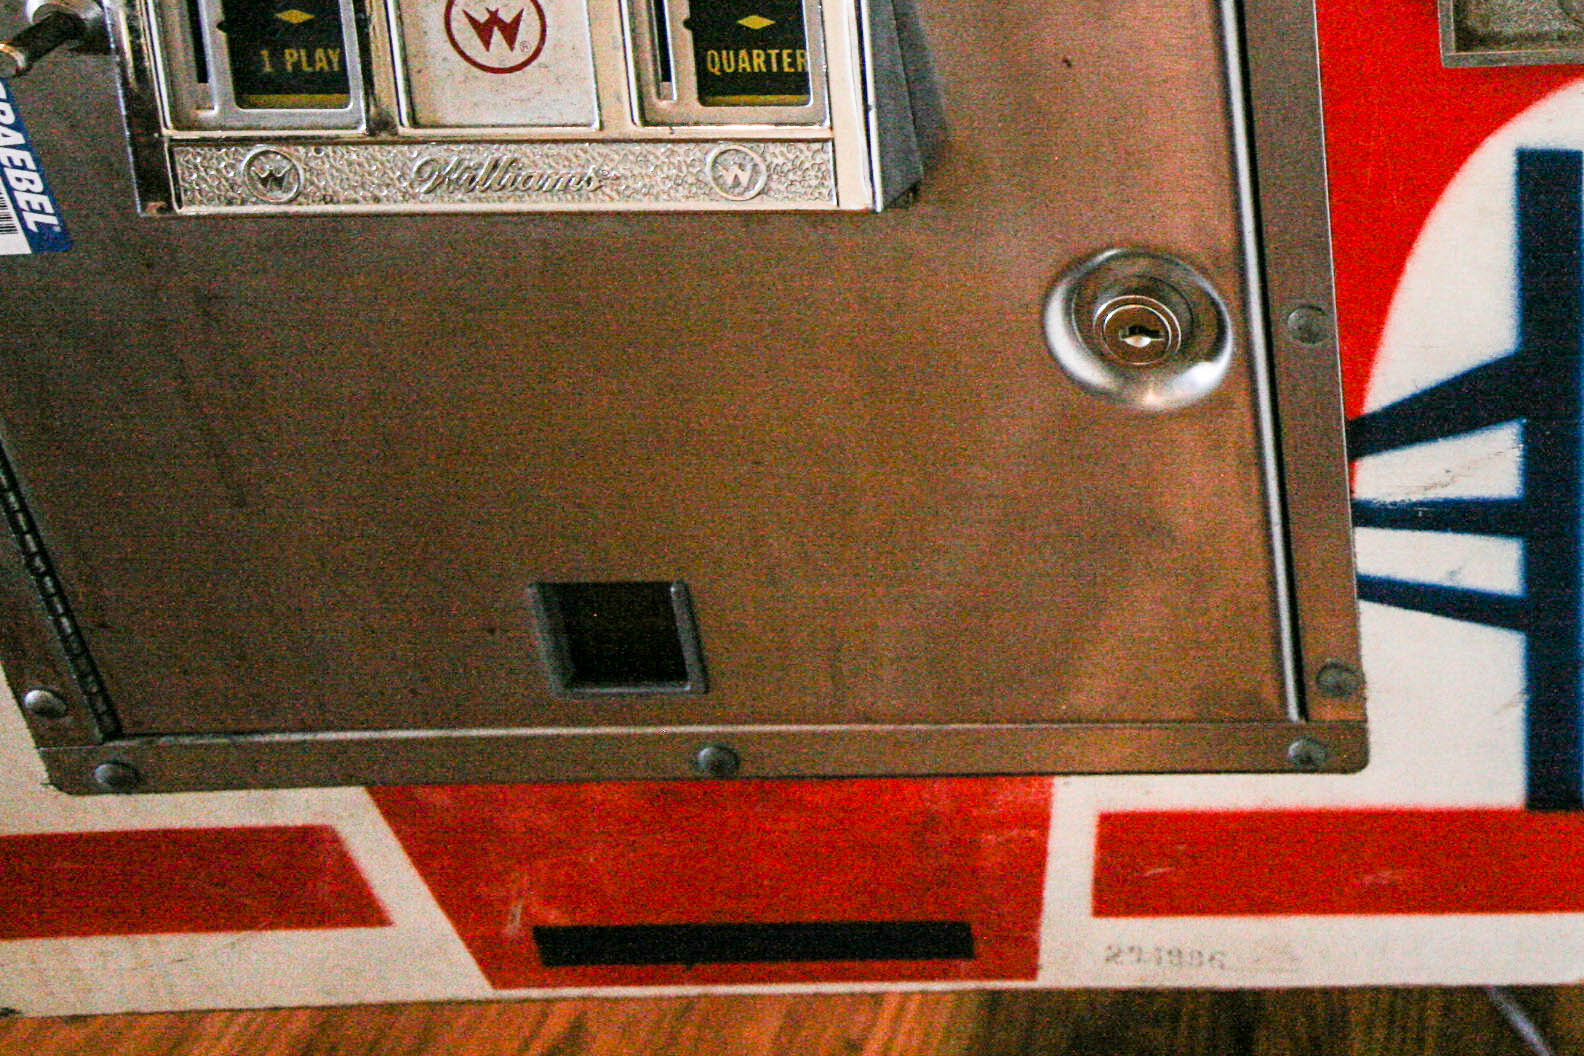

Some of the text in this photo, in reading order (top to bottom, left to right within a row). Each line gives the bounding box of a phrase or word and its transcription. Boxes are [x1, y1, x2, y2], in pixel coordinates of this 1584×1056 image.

[260, 47, 342, 73] 1 PLAY
[705, 48, 809, 76] QUARTER
[0, 80, 62, 233] AEBEL
[409, 153, 604, 195] Williams
